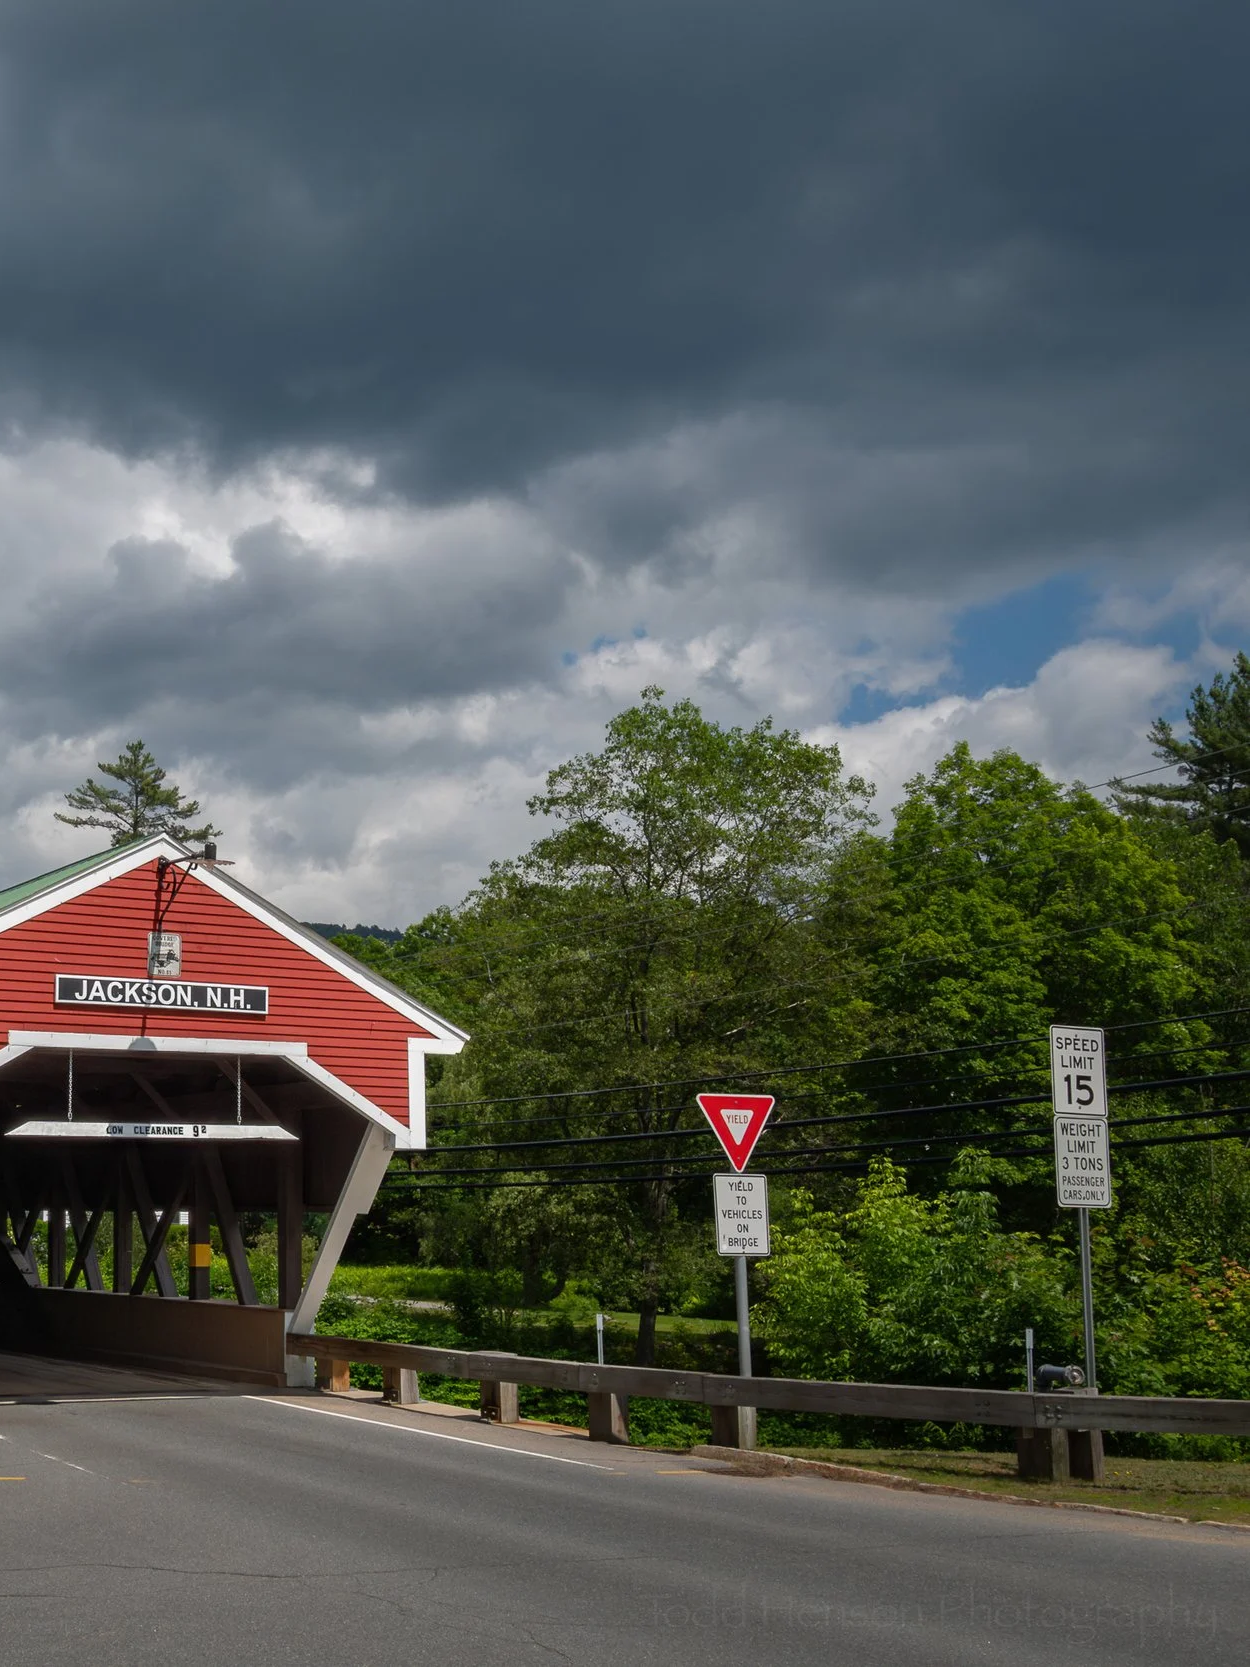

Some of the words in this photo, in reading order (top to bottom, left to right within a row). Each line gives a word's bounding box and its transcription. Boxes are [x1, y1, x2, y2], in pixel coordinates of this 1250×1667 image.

[75, 979, 199, 1007] JACKSON,
[207, 987, 251, 1009] N.H.
[1056, 1037, 1099, 1052] SPEED
[1061, 1055, 1095, 1070] LIMIT
[1064, 1074, 1094, 1106] 15
[726, 1114, 748, 1124] YIELD
[106, 1126, 123, 1135] LOW
[134, 1126, 184, 1135] CLEARANCE
[1061, 1123, 1102, 1138] WEIGHT
[1067, 1139, 1096, 1154] LIMIT
[1062, 1157, 1069, 1170] 3
[1074, 1157, 1103, 1171] TONS
[728, 1181, 754, 1192] YIELD
[1062, 1176, 1105, 1187] PASSENGER
[736, 1196, 746, 1206] TO
[1064, 1190, 1083, 1201] CARS
[1085, 1191, 1105, 1201] ONLY
[722, 1210, 763, 1220] VEHICLES
[737, 1224, 749, 1234] ON
[728, 1238, 759, 1248] BRIDGE
